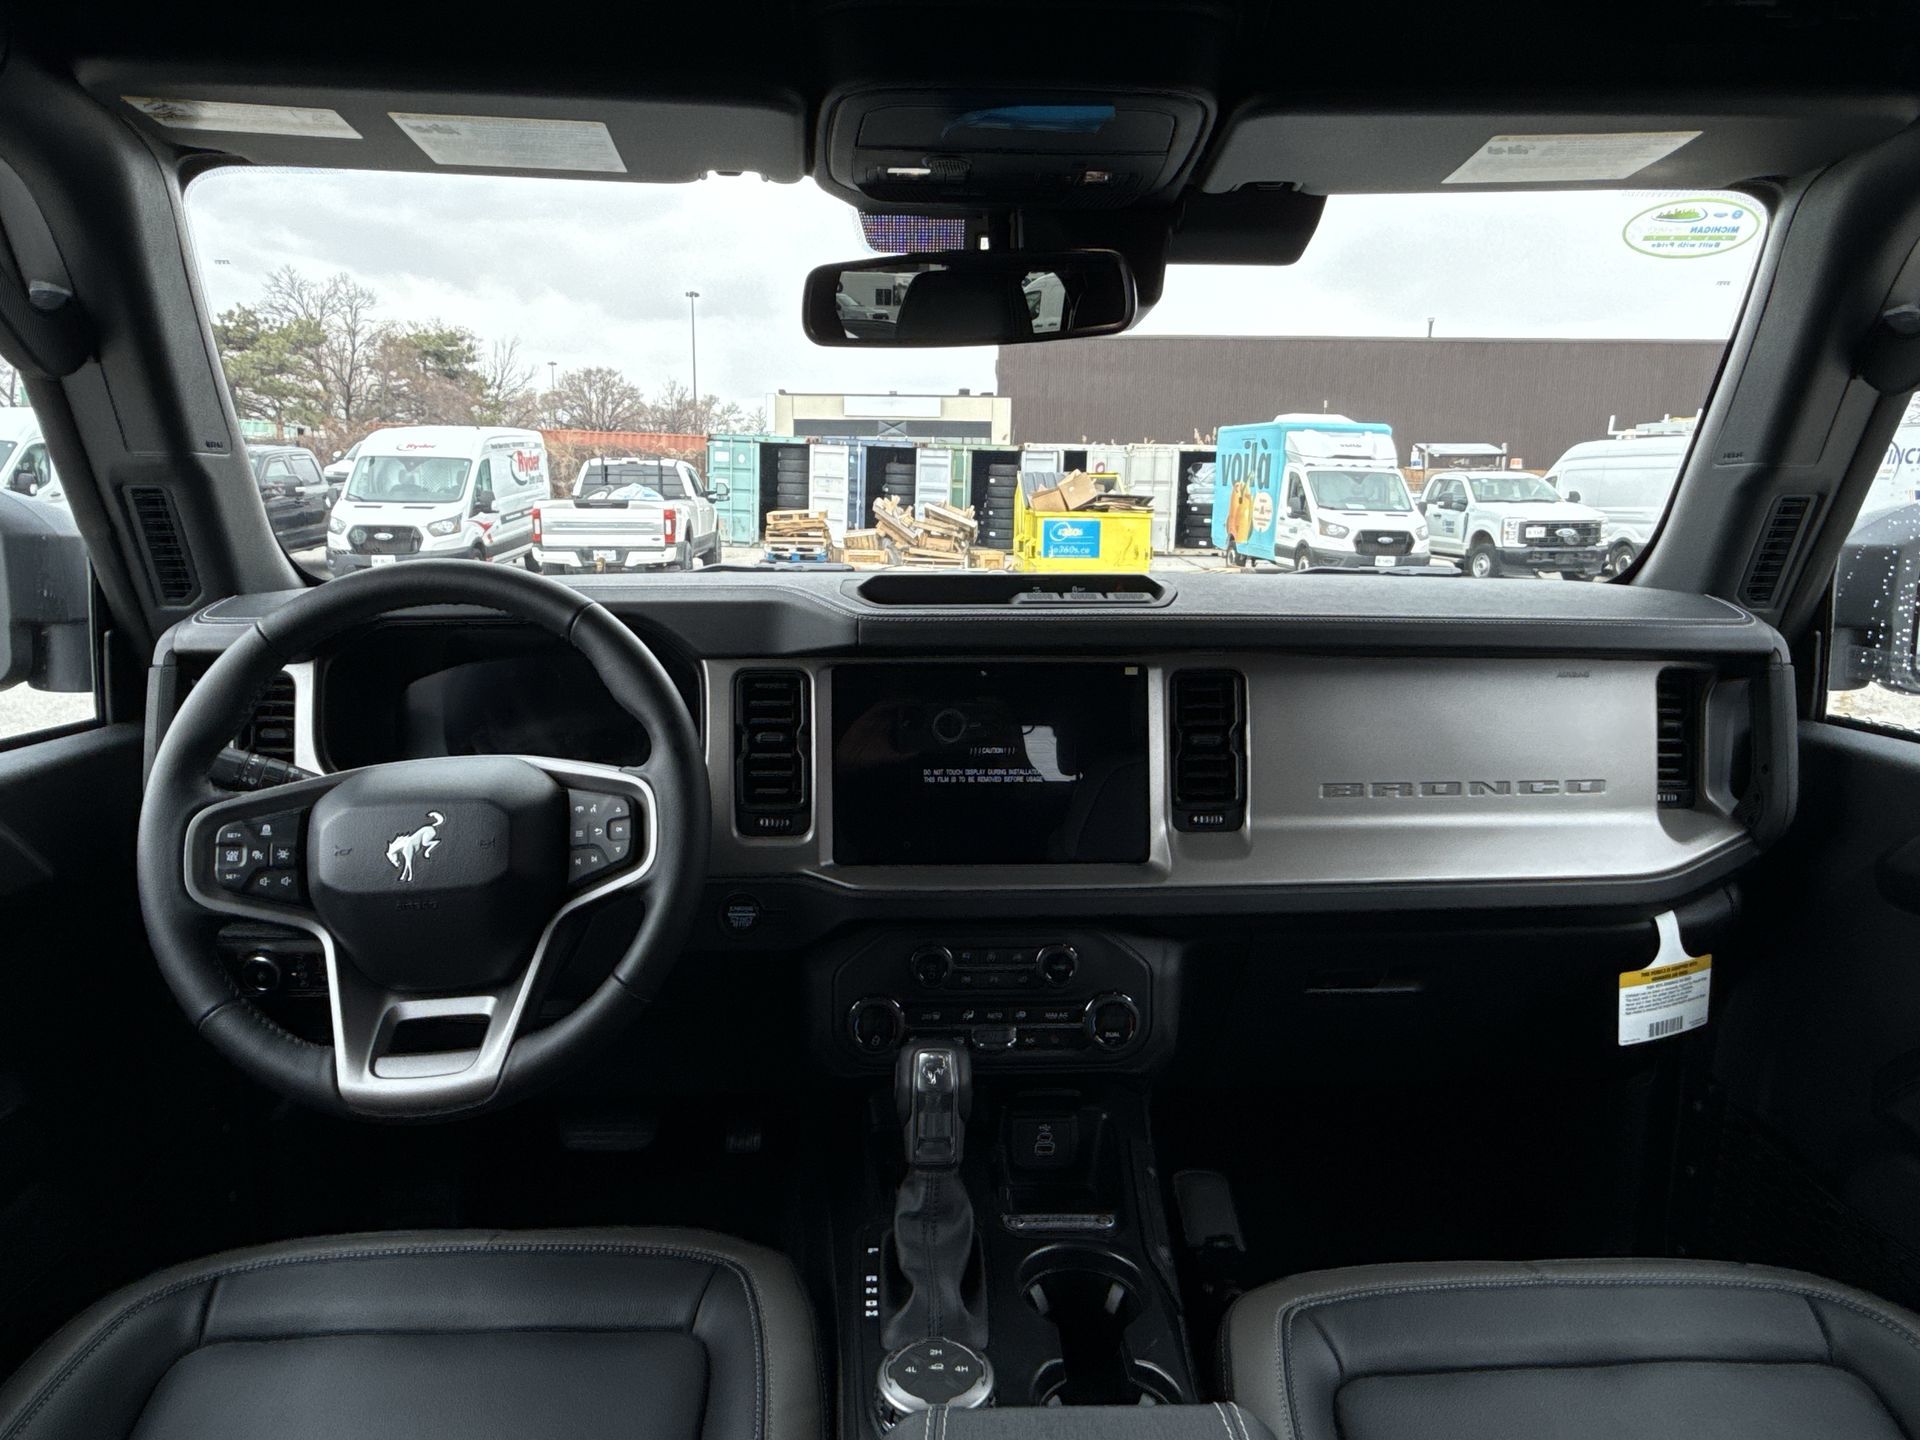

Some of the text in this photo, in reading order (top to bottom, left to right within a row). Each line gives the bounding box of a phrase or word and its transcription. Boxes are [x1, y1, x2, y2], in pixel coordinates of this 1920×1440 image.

[517, 450, 540, 477] Ryder
[1221, 439, 1272, 490] voilà
[1319, 779, 1606, 799] BRONCO
